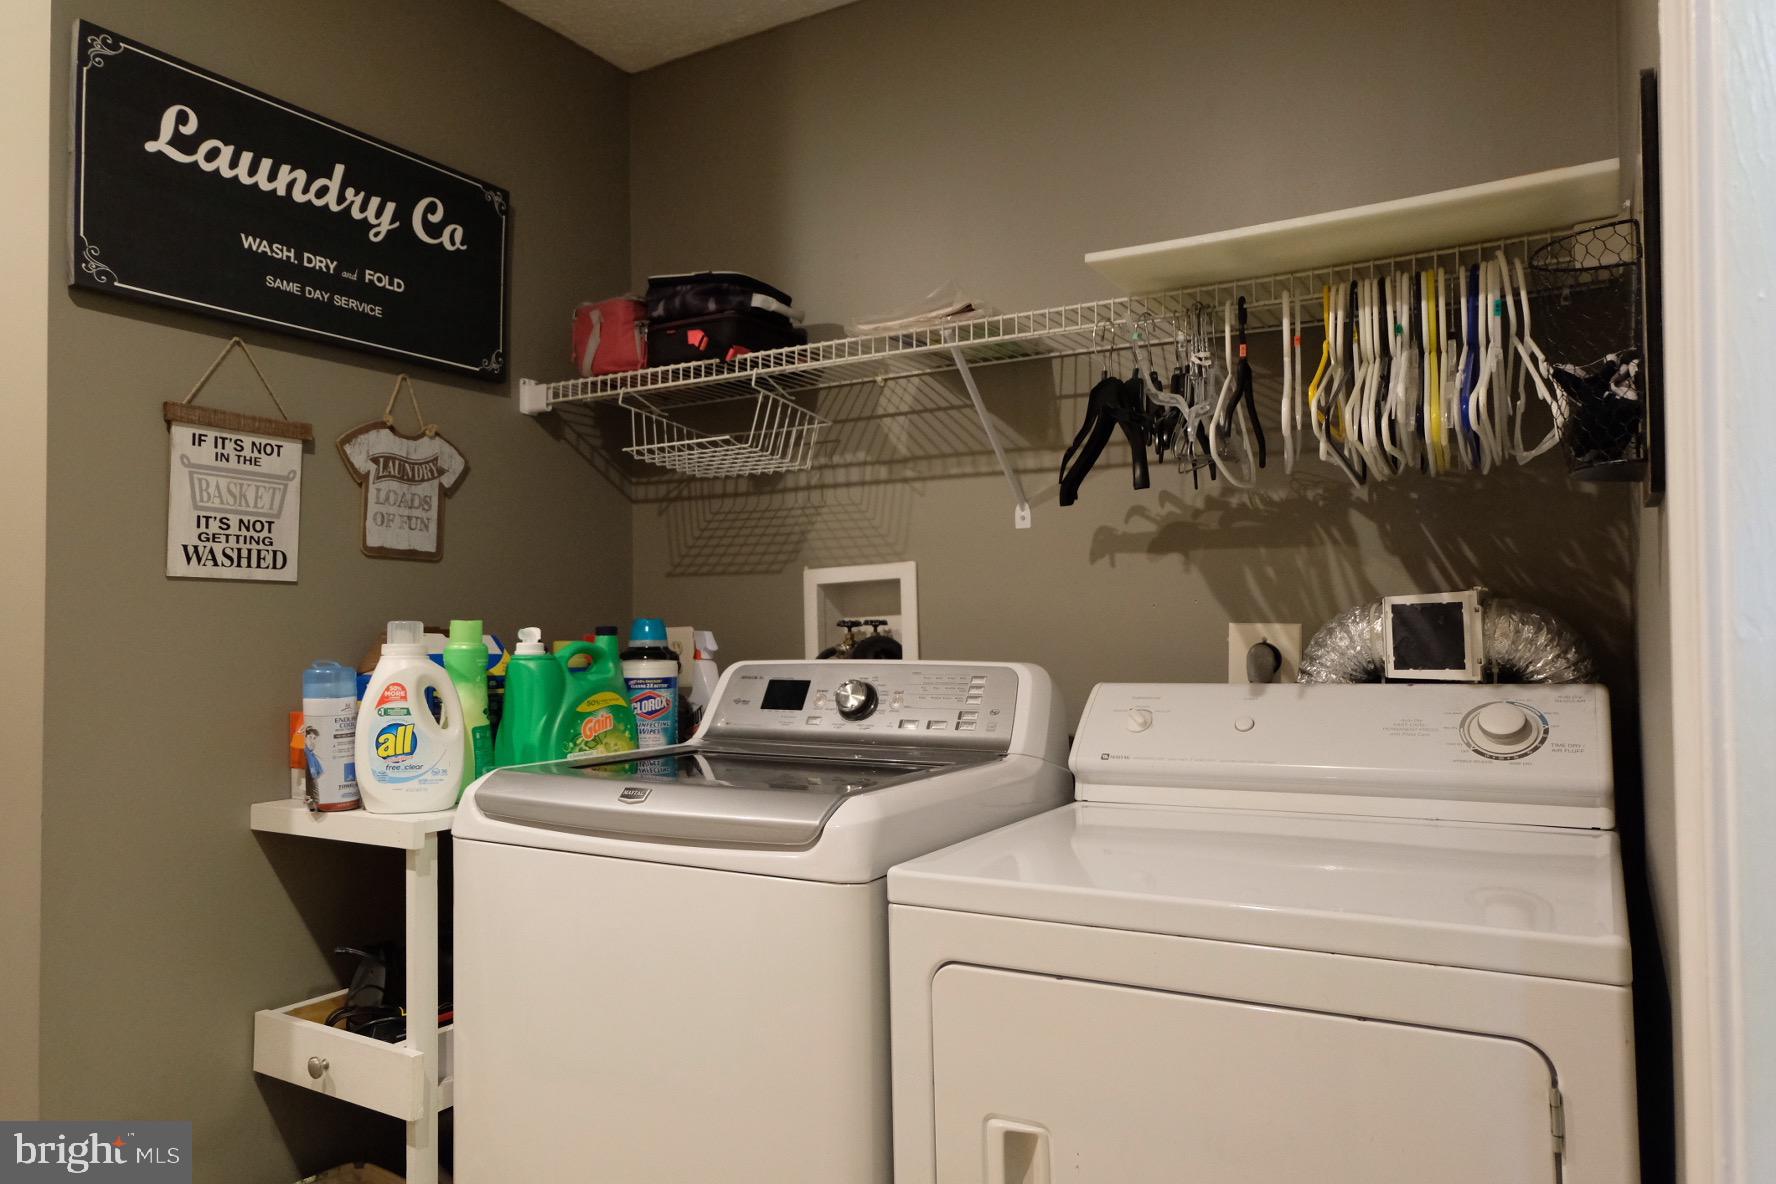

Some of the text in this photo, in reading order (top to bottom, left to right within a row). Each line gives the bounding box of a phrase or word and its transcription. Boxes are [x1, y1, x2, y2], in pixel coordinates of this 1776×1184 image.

[144, 104, 467, 251] Laundry Co
[303, 251, 338, 275] DRY
[341, 268, 358, 282] and
[365, 269, 405, 293] FOLD
[265, 275, 383, 318] SAME DAY SERVICE
[191, 432, 283, 458] IF IT'S NOT
[214, 451, 262, 467] IN THE
[378, 457, 440, 480] LAUNDRY
[198, 478, 281, 511] BASKET
[374, 487, 432, 513] LOADS
[196, 515, 275, 534] IT'S NOT
[372, 510, 431, 533] OF FUN
[197, 532, 274, 547] GETTING
[181, 543, 288, 571] WASHED
[632, 696, 668, 714] CLOROX
[582, 713, 614, 741] Gain
[377, 723, 415, 760] all
